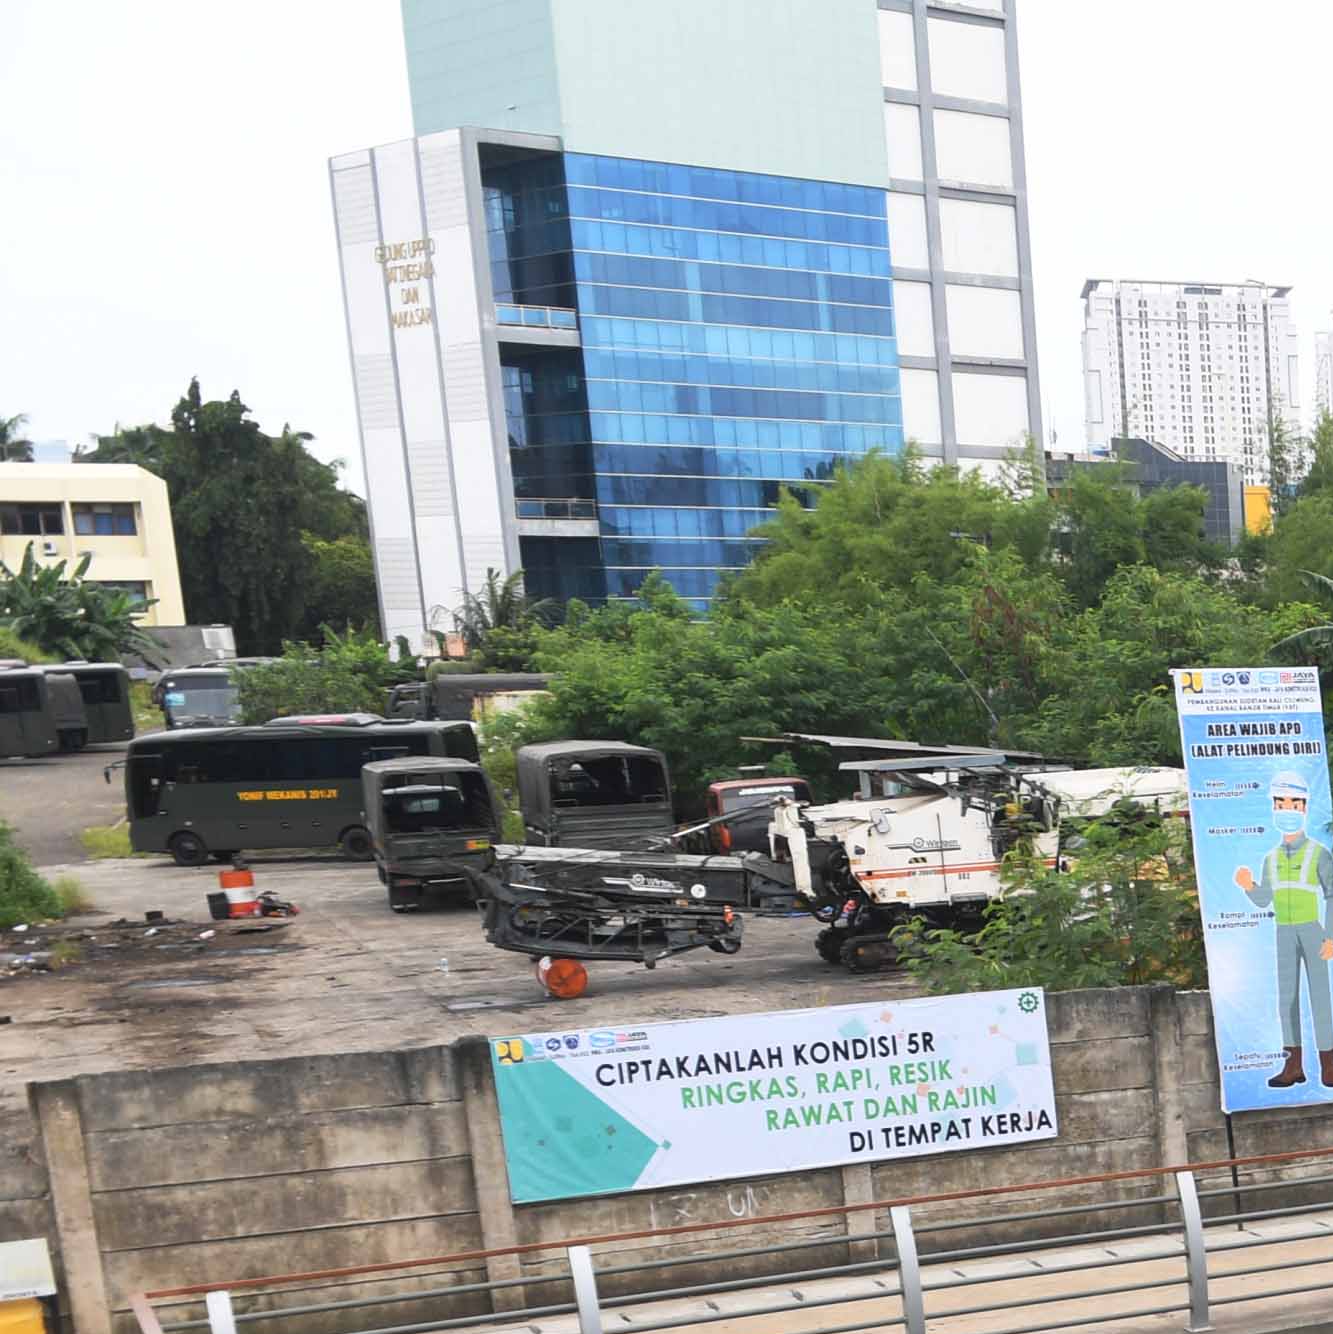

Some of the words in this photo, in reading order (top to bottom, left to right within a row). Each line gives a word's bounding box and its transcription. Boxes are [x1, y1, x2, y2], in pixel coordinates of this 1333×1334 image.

[1191, 744, 1223, 758] (ALAT
[1223, 743, 1290, 757] PELINDUNG
[1293, 742, 1321, 755] DIRI)
[1207, 724, 1237, 737] AREA
[1239, 723, 1276, 736] WAJIB
[1279, 722, 1301, 735] APD
[595, 1046, 784, 1087] CIPTAKANLAH
[793, 1034, 898, 1066] KONDISI
[907, 1031, 936, 1055] 5R
[680, 1075, 806, 1109] RINGKAS,
[815, 1068, 881, 1094] RAPI,
[889, 1059, 953, 1085] RESIK
[766, 1100, 855, 1131] RAWAT
[864, 1094, 918, 1119] DAN
[927, 1085, 997, 1112] RAJIN
[849, 1130, 874, 1152] DI
[885, 1118, 972, 1148] TEMPAT
[981, 1109, 1053, 1137] KERJA
